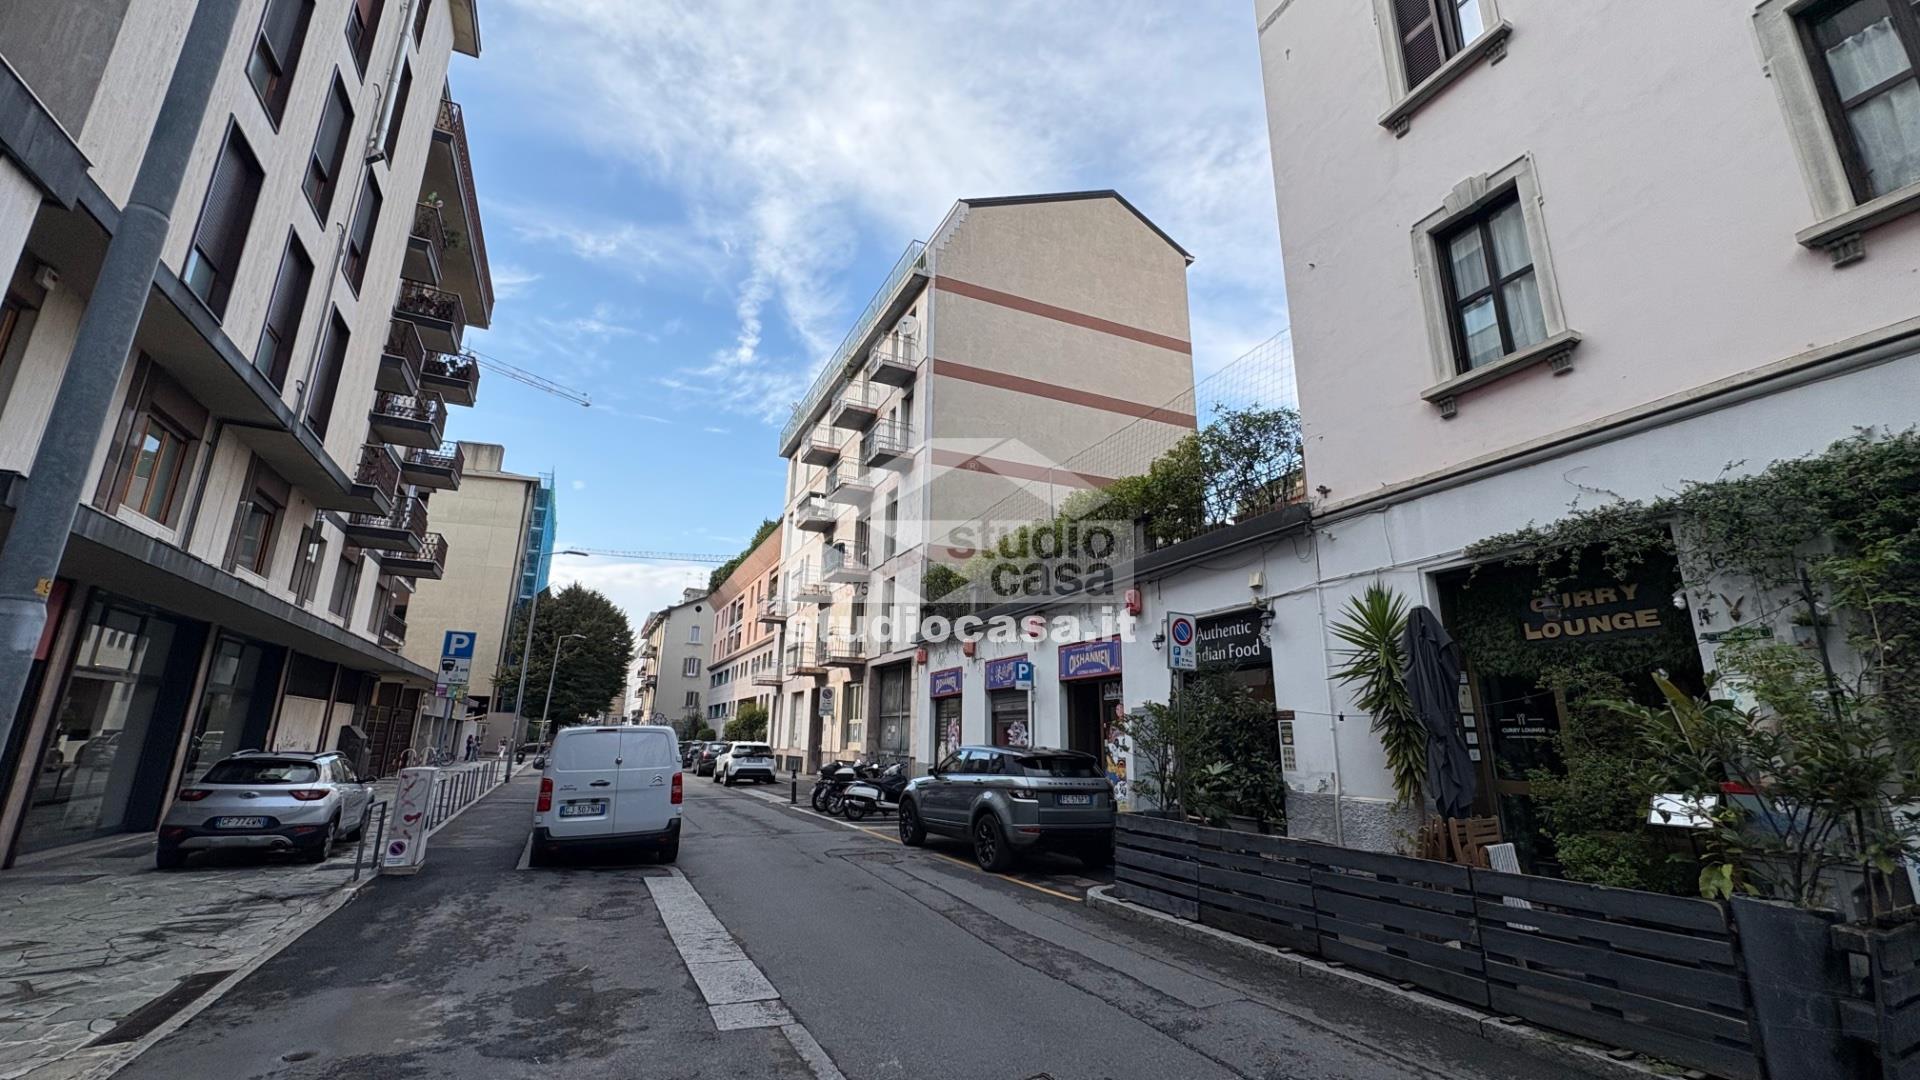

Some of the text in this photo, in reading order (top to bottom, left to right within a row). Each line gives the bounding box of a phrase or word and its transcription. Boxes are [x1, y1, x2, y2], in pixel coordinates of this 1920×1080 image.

[1195, 619, 1252, 642] Authentic
[1523, 608, 1662, 640] LOUNGE
[448, 633, 470, 655] P
[1196, 645, 1226, 662] ndian
[1228, 638, 1260, 659] Food
[1018, 663, 1029, 679] P
